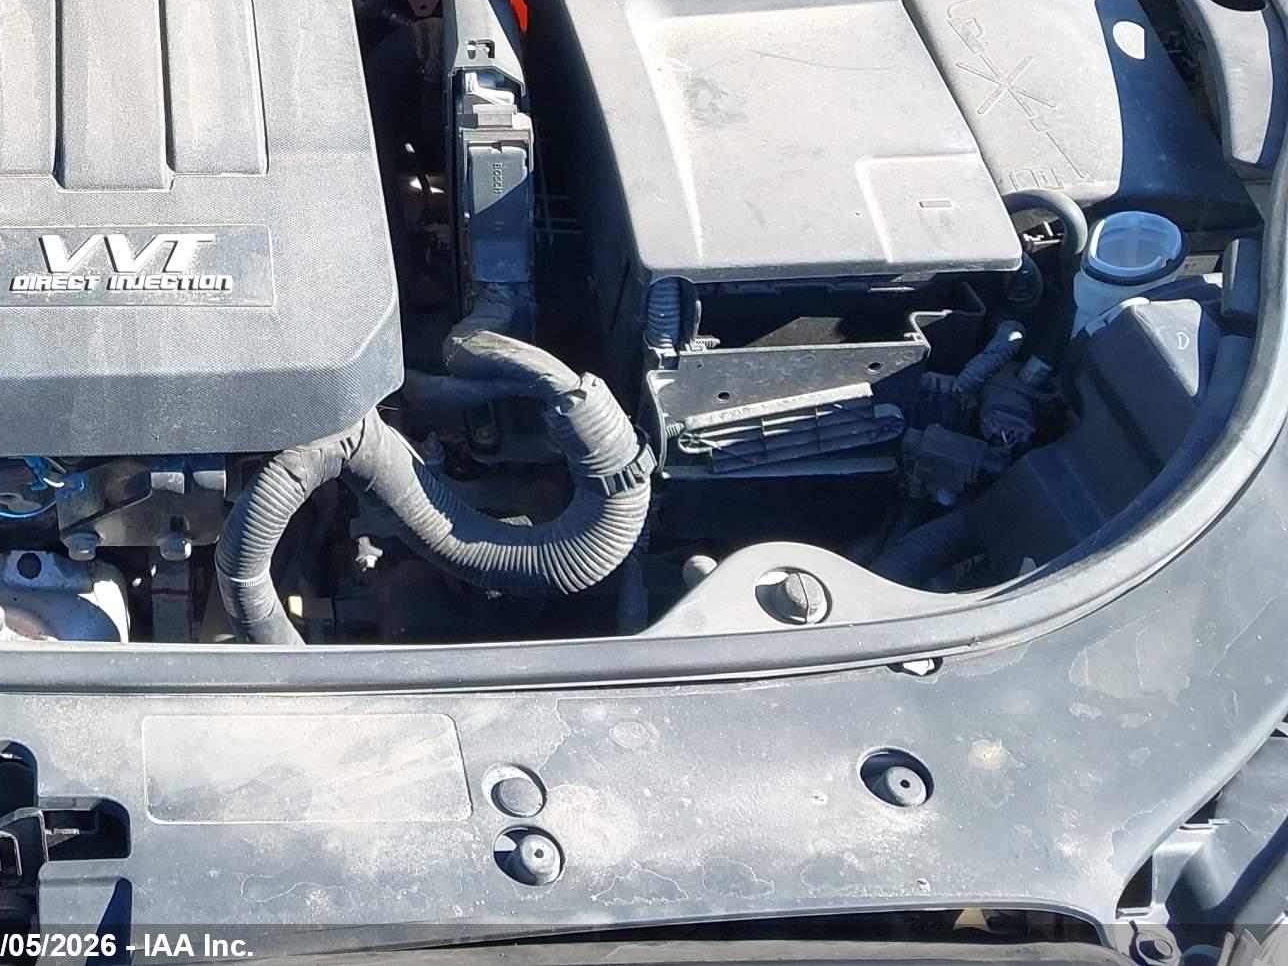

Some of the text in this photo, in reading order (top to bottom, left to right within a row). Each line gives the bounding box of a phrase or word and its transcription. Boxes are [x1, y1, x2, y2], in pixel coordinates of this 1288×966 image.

[493, 162, 503, 195] BOSCH
[39, 234, 216, 275] VVT
[9, 274, 233, 293] DIRECT INJECTION
